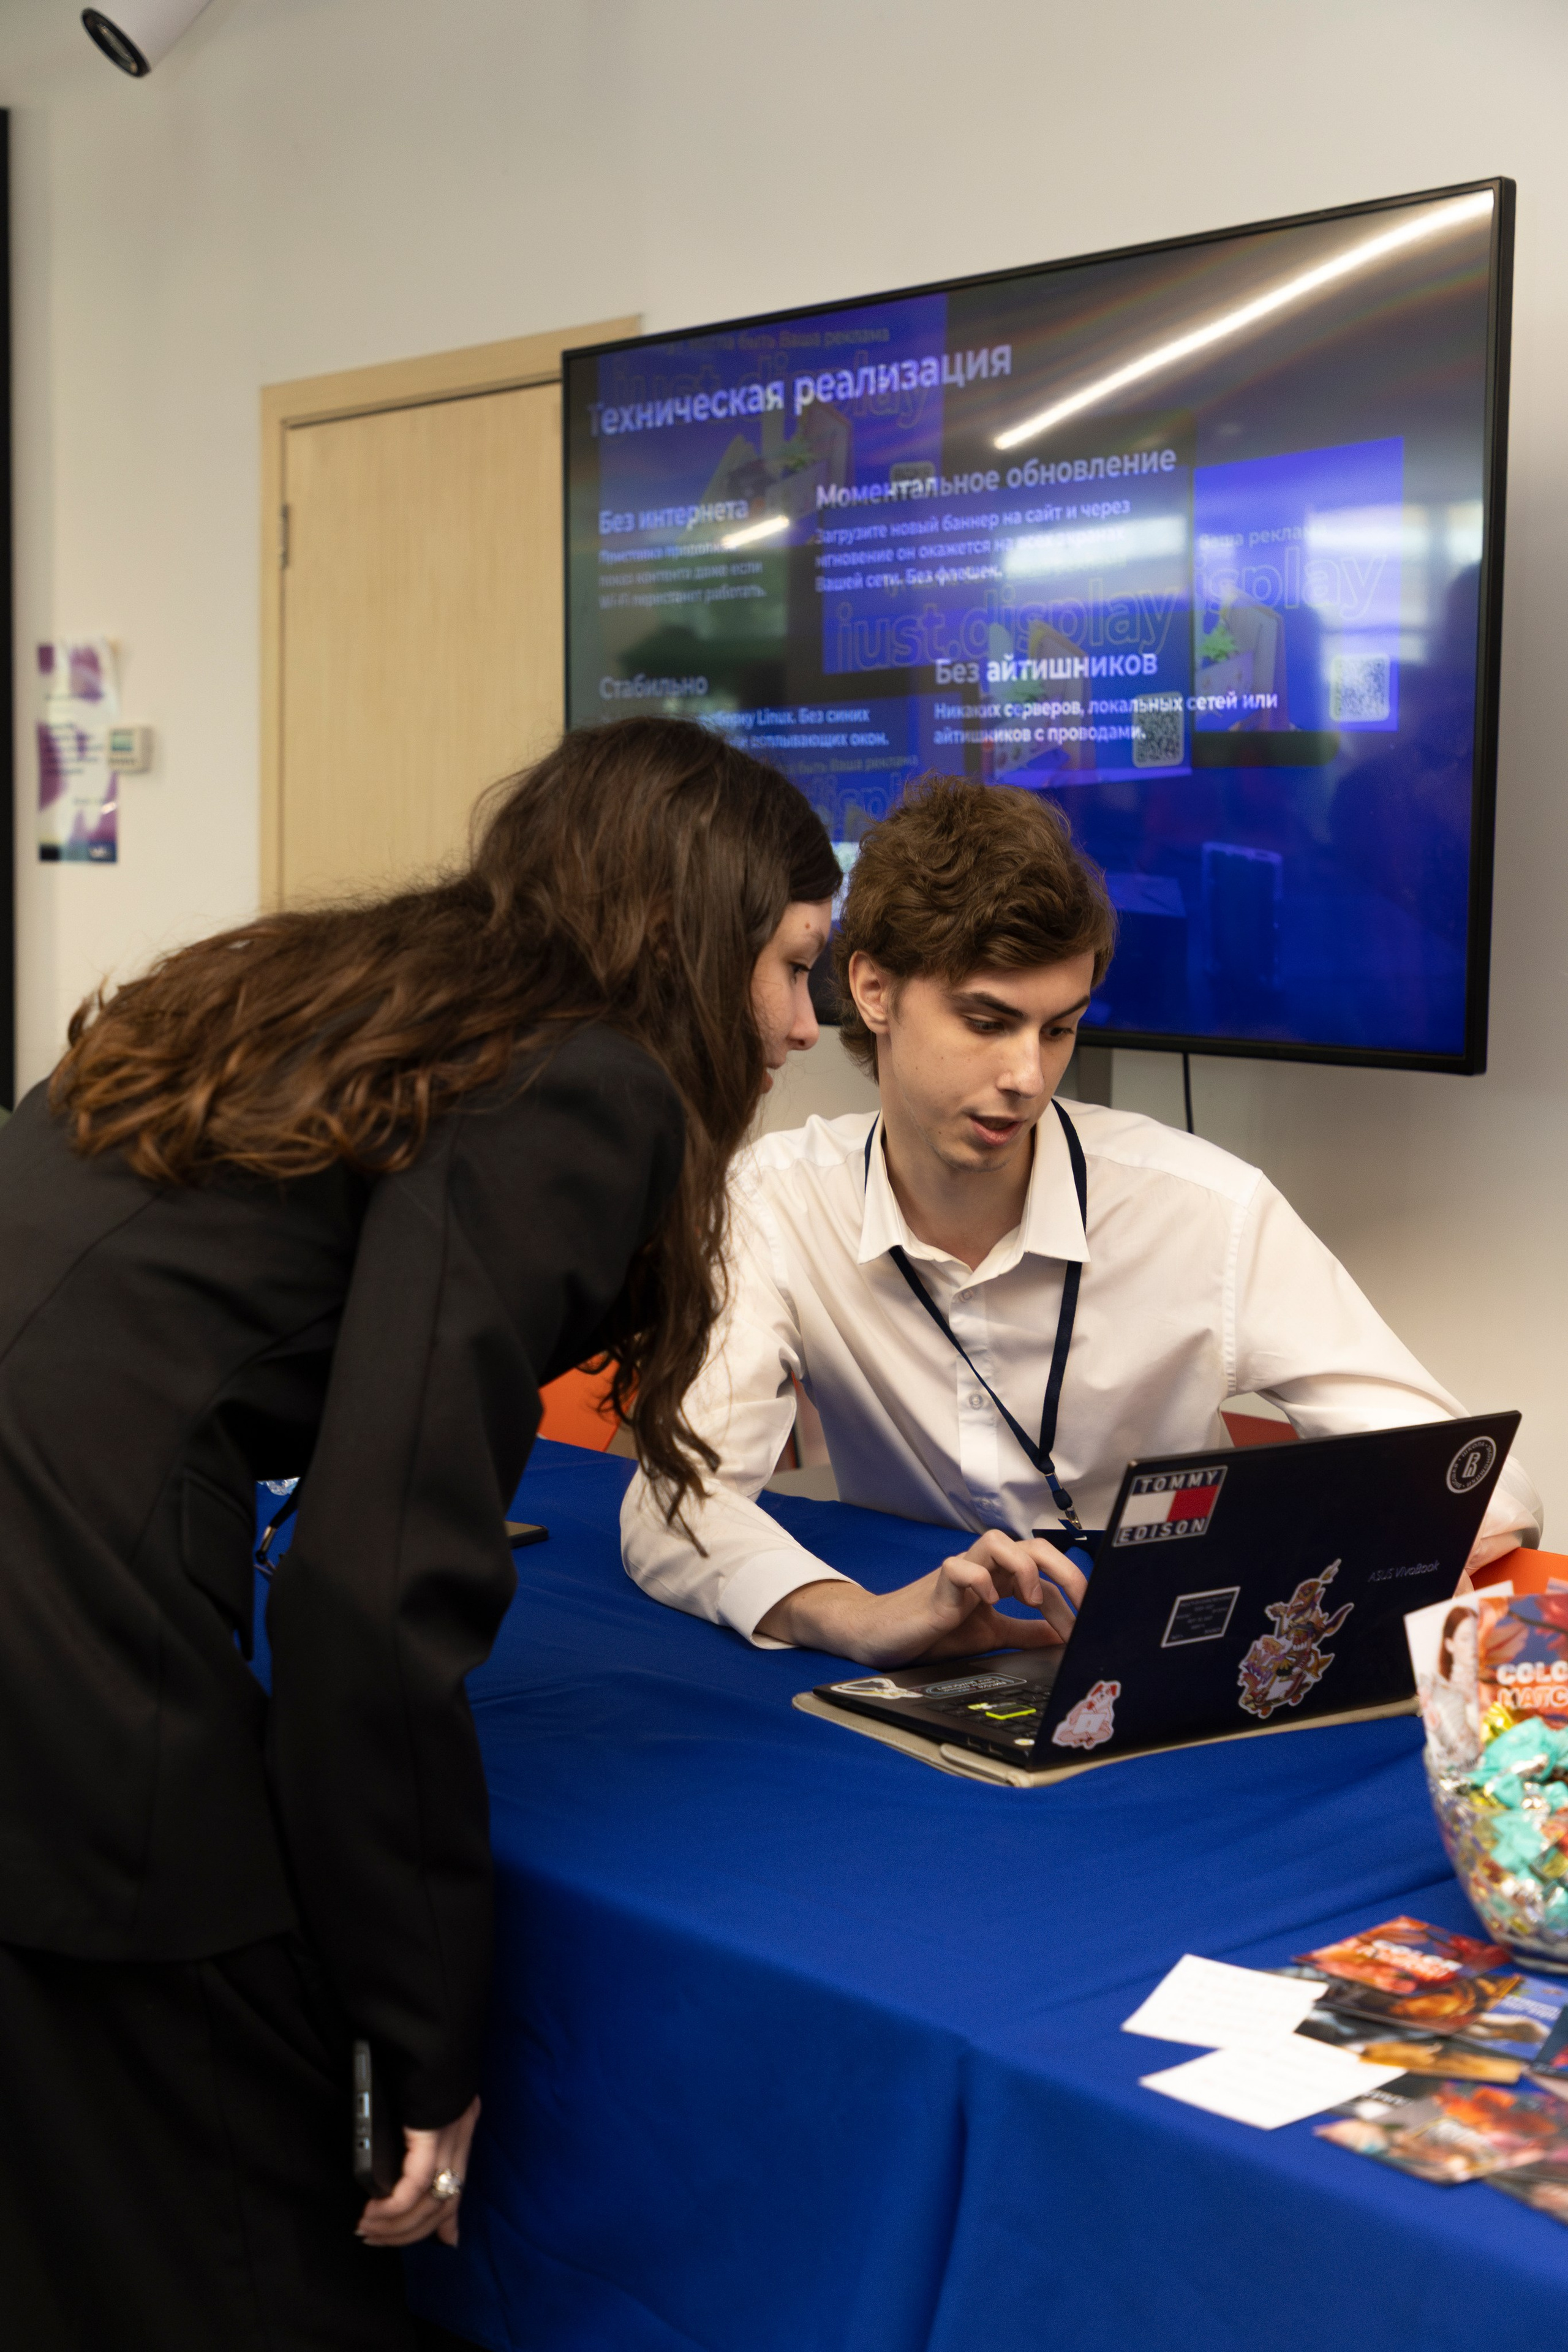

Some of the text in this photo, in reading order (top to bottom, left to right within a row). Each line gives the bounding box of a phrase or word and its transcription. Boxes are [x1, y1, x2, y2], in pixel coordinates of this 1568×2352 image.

[588, 344, 1012, 437] Техническая реализация
[816, 448, 1177, 509] Моментальное обновление
[598, 499, 749, 536] Без интернета
[890, 515, 939, 537] новый
[941, 508, 999, 534] баннер
[1003, 510, 1022, 526] на
[1025, 502, 1063, 524] сайт
[1066, 505, 1077, 520] и
[1080, 498, 1131, 521] через
[897, 546, 916, 562] он
[919, 539, 991, 560] окажется
[994, 537, 1014, 552] на
[935, 652, 1158, 686] Без айтишников
[599, 673, 709, 700] Стабильно
[934, 690, 1278, 722] Никаких серверов, локальных сетей или
[934, 723, 1147, 748] айтишников с проводами.
[1140, 1470, 1219, 1493] TOMMY
[1119, 1518, 1206, 1543] EDISON
[1368, 1567, 1395, 1583] ASUS
